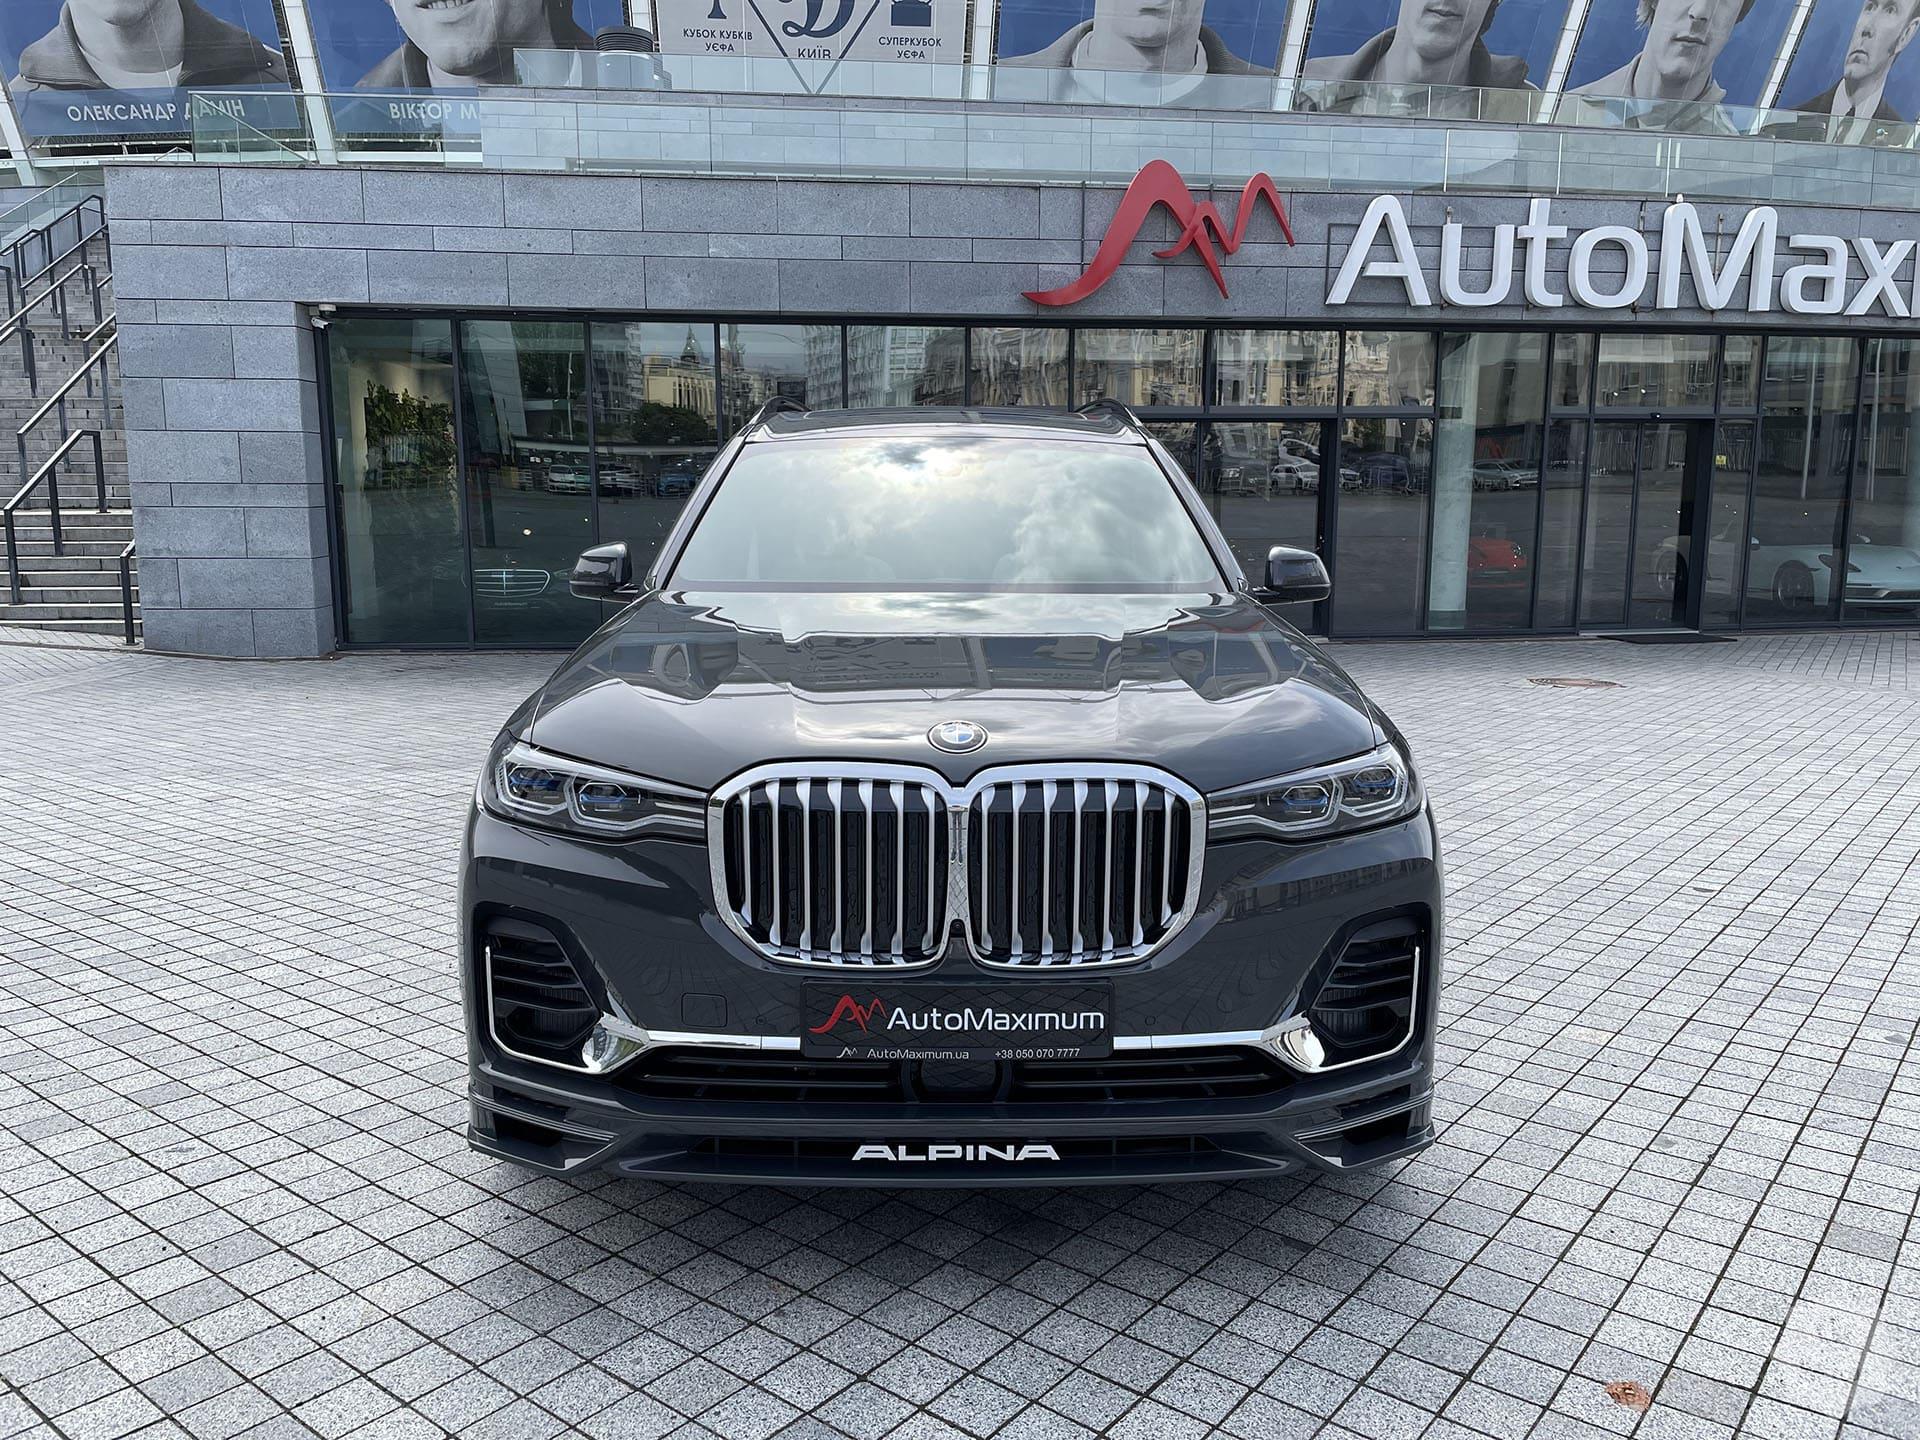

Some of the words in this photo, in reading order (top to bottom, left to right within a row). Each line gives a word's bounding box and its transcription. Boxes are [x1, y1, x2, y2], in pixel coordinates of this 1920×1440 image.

[683, 28, 717, 39] КУБОК
[719, 30, 753, 40] КУБКІВ
[705, 42, 735, 53] УЄФА
[878, 36, 942, 47] СУПЕРКУБОК
[797, 44, 832, 59] КИЇВ
[896, 50, 926, 59] УЄФА
[67, 103, 177, 122] ОЛЕКСАНДР
[183, 99, 246, 121] ДАМІН
[388, 103, 453, 119] ВІКТОР
[460, 103, 478, 119] М
[886, 1007, 1105, 1031] AutoMaximum
[867, 1048, 969, 1060] AutoMaximum.ua
[995, 1049, 1014, 1059] +38
[1015, 1049, 1034, 1059] 050
[1036, 1048, 1054, 1058] 070
[1056, 1047, 1080, 1057] 7777
[851, 1144, 1061, 1161] ALPINA
